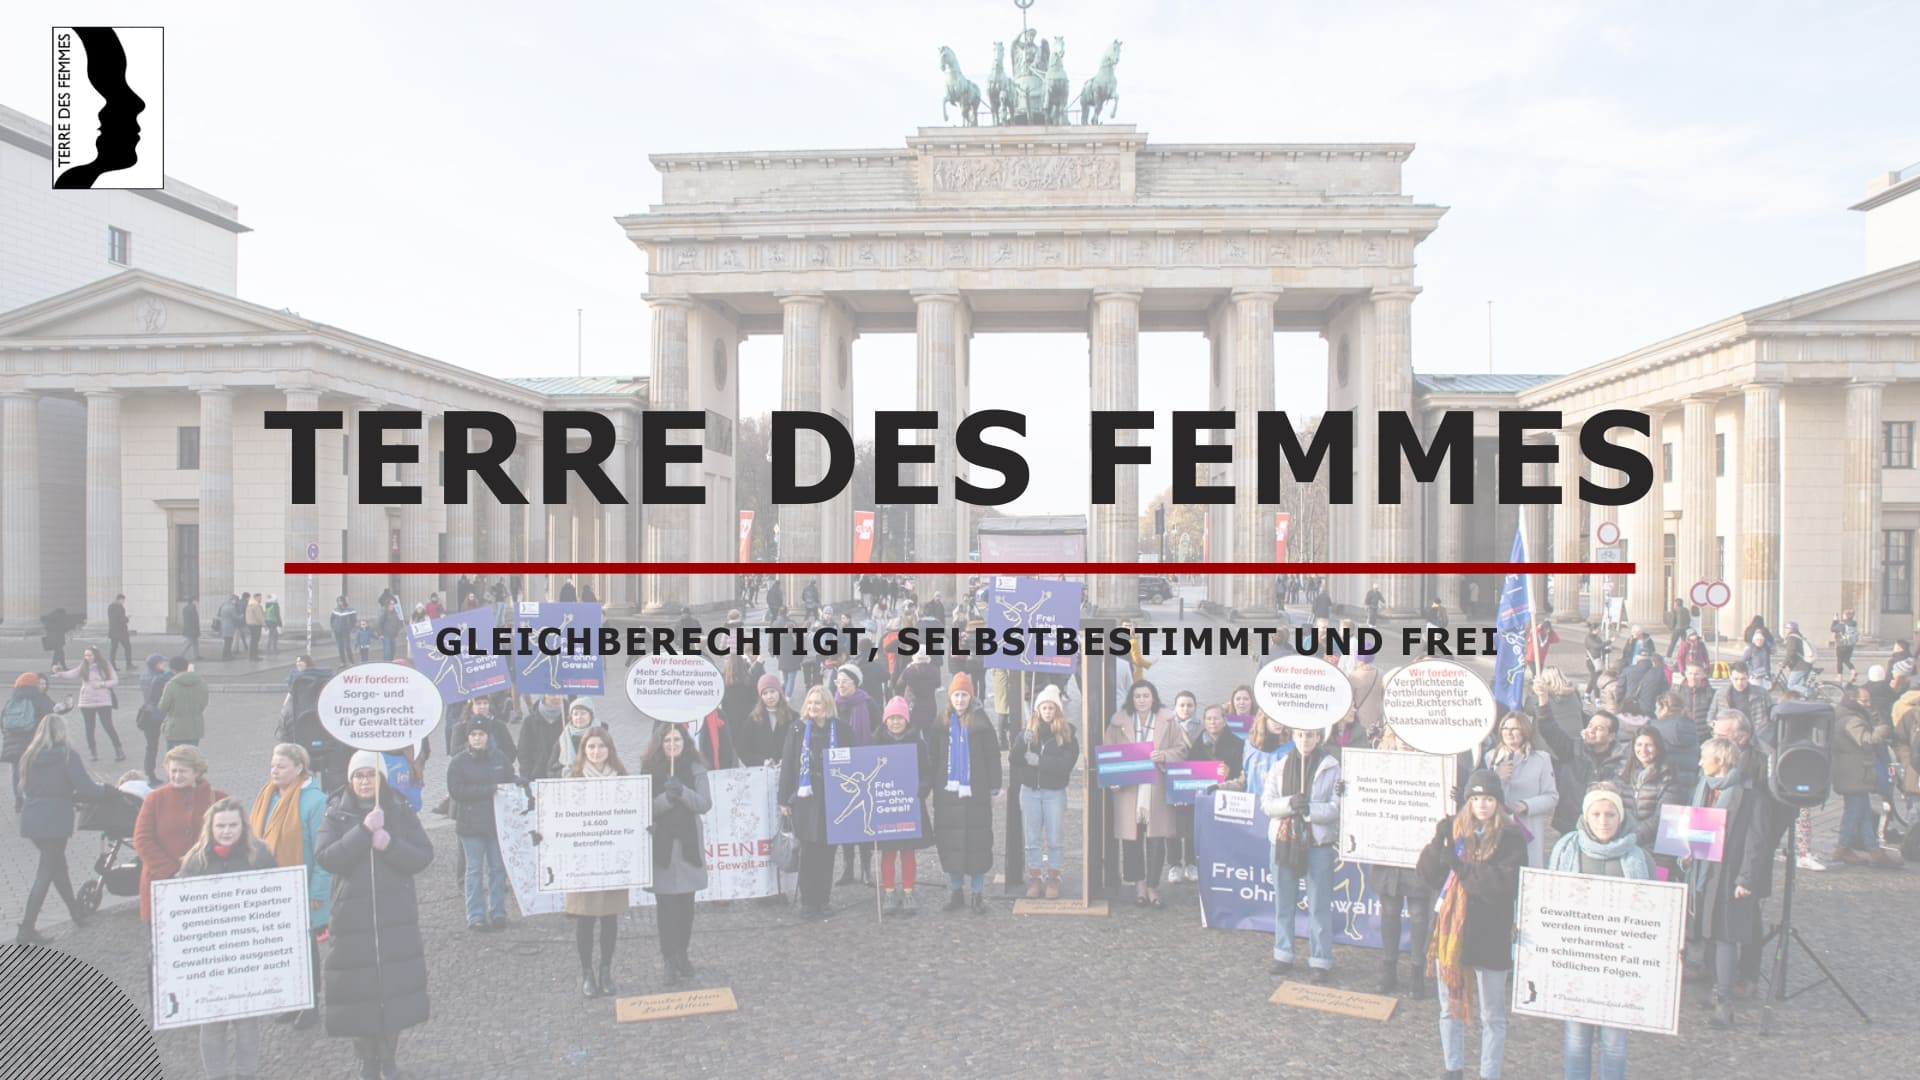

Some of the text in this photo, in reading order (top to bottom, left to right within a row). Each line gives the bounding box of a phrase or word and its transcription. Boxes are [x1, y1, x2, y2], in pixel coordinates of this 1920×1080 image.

[561, 660, 594, 670] Gewalt
[652, 657, 705, 666] Wir fordern:
[635, 668, 718, 677] Mehr Schutzräume
[1273, 665, 1327, 676] Wir fordern:
[1408, 668, 1468, 678] Wir fordern:
[343, 674, 409, 685] Wir fordern:
[633, 678, 647, 686] für
[648, 678, 696, 687] Betroffene
[1393, 678, 1465, 689] Verpflichtende
[1262, 680, 1336, 693] Femizide endlich
[343, 688, 405, 700] Sorge- und
[636, 688, 682, 696] häuslicher
[683, 688, 715, 697] Gewalt
[1270, 690, 1308, 700] wirksam
[333, 705, 415, 716] Umgangsrecht
[1428, 708, 1447, 717] und
[339, 716, 425, 727] für Gewalttäter
[350, 729, 405, 739] aussetzen
[875, 781, 894, 790] Frei
[1356, 775, 1378, 784] Jeden
[1379, 776, 1393, 786] Tag
[1394, 778, 1427, 788] versucht
[875, 789, 904, 797] leben
[1358, 786, 1378, 794] Mann
[1361, 796, 1378, 804] eine
[1379, 797, 1396, 805] Frau
[564, 808, 612, 819] Deutschland
[613, 807, 638, 816] fehlen
[876, 805, 910, 813] Gewalt
[1355, 809, 1377, 818] Jeden
[1211, 862, 1255, 882] Frei
[178, 884, 282, 903] Wenn eine Frau dem
[169, 895, 293, 919] gewalttätigen Expartner
[181, 909, 282, 930] gemeinsame Kinder
[1606, 914, 1621, 924] an
[1623, 914, 1662, 928] Frauen
[172, 920, 292, 944] übergeben muss, ist sie
[1541, 919, 1658, 941] werden immer wieder
[181, 934, 284, 955] erneut einem hohen
[1560, 934, 1625, 950] verharmlost
[172, 946, 294, 969] Gewaltrisiko ausgesetzt
[1535, 944, 1662, 968] im schlimmsten Fall mit
[186, 969, 207, 981] und
[208, 966, 226, 977] die
[227, 962, 261, 975] Kinder
[1551, 958, 1643, 979] tödlichen Folgen.
